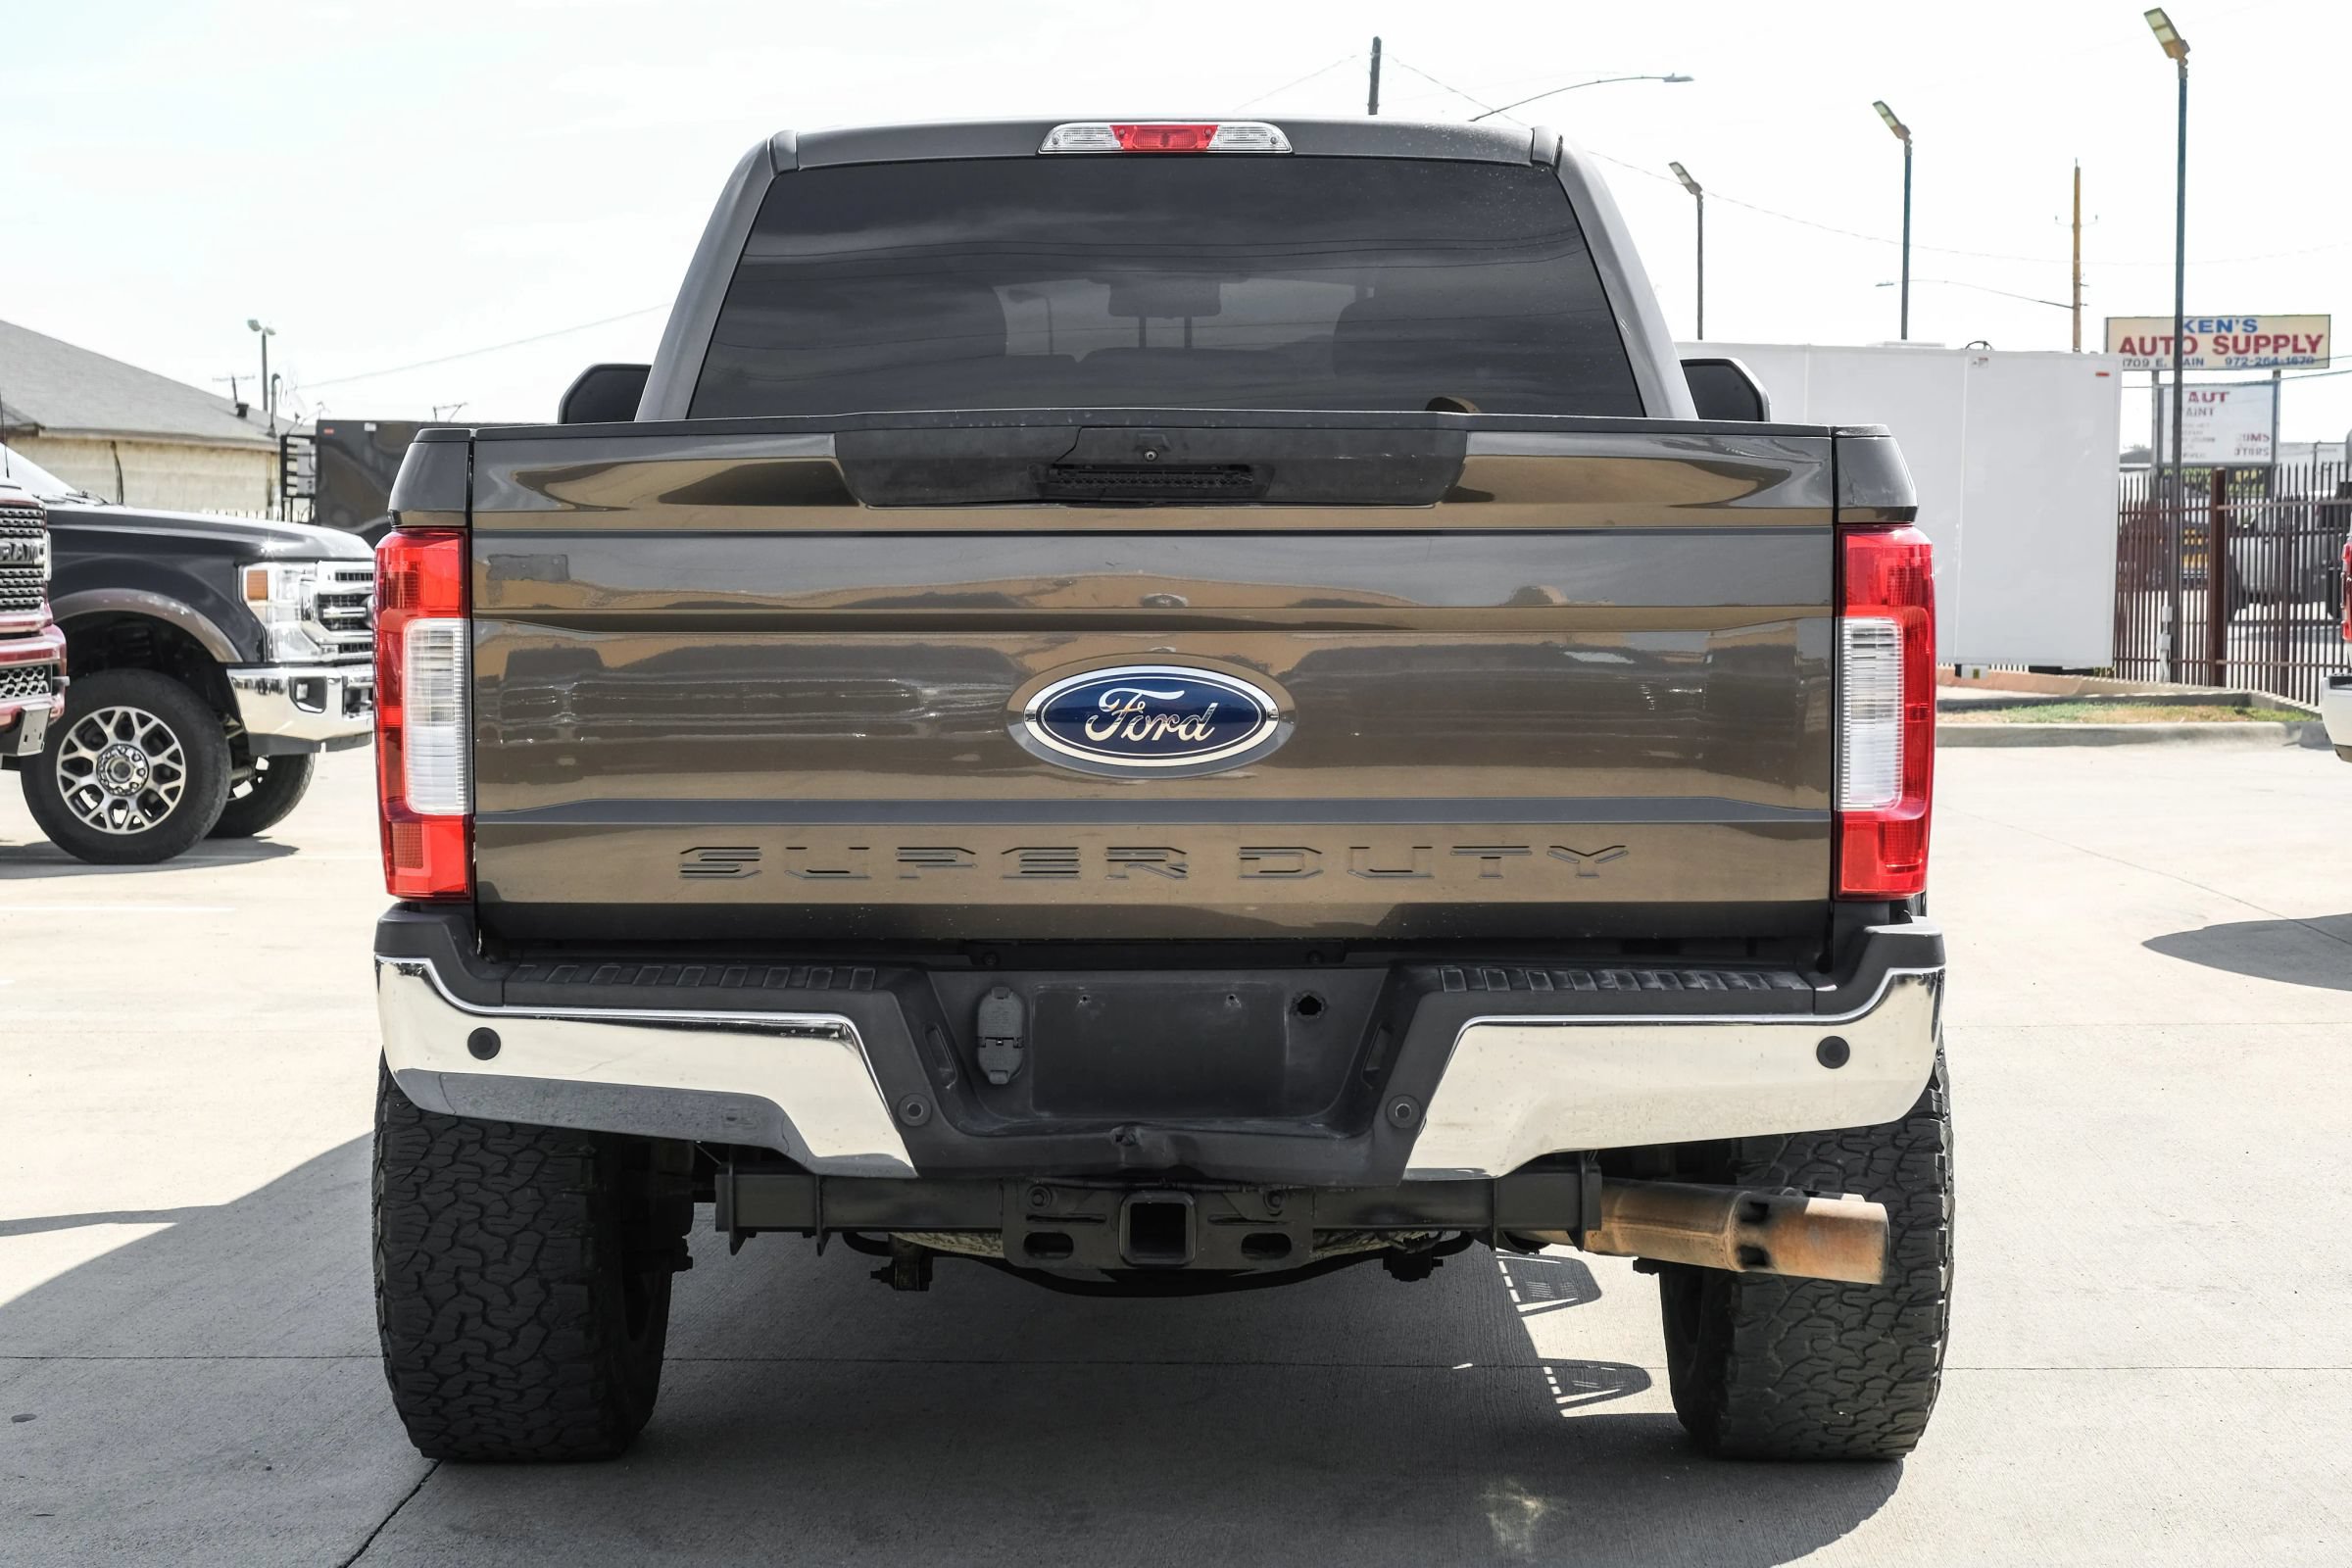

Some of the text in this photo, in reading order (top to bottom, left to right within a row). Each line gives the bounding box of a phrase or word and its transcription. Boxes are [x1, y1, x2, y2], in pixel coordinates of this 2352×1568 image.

[2182, 318, 2258, 333] KEN'S
[2119, 334, 2324, 356] AUTO SUPPLY
[2178, 357, 2204, 367] AIN
[1085, 687, 1218, 742] Ford
[680, 845, 1629, 879] SUPER DUTY
